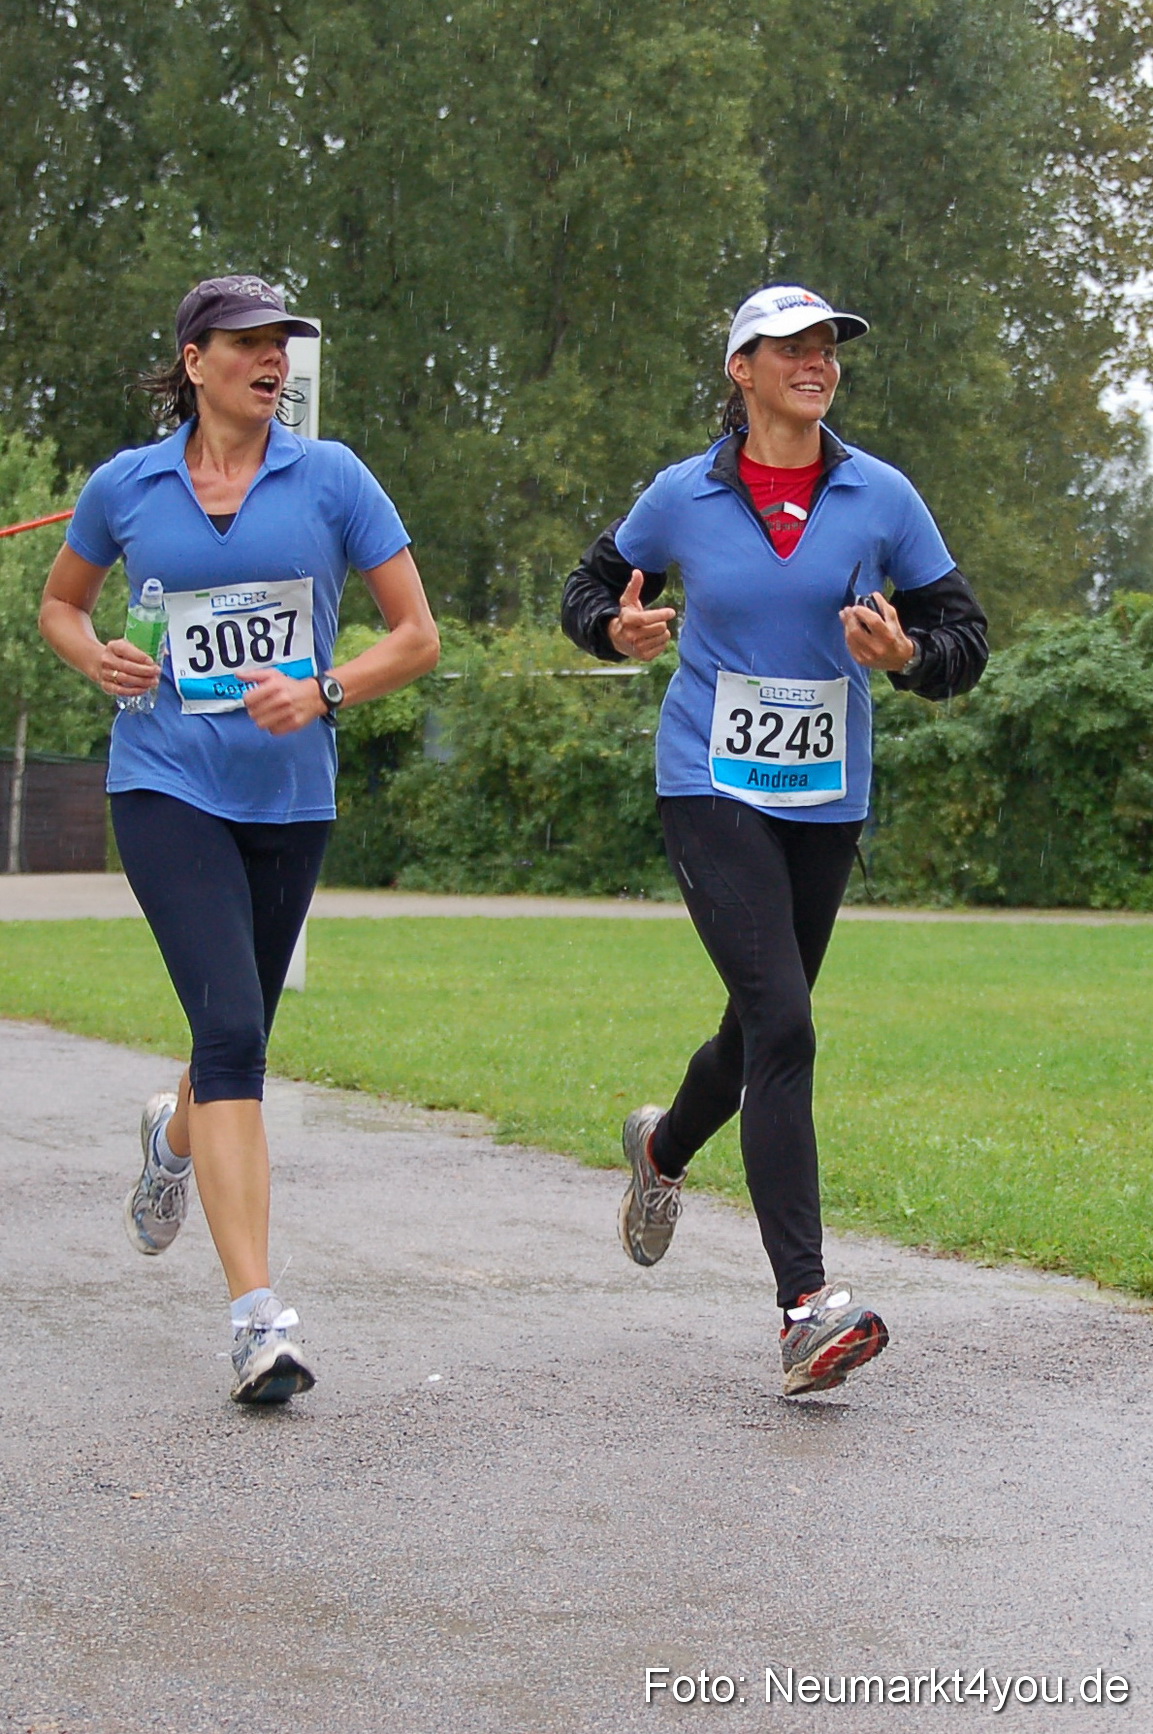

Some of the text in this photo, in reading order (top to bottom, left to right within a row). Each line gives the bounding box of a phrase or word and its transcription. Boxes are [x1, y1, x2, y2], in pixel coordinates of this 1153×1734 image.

[211, 590, 267, 608] BOCK
[185, 610, 298, 673] 3087
[213, 680, 259, 697] Corn
[760, 686, 816, 702] BOCK
[725, 708, 834, 760] 3243
[746, 768, 808, 788] Andrea
